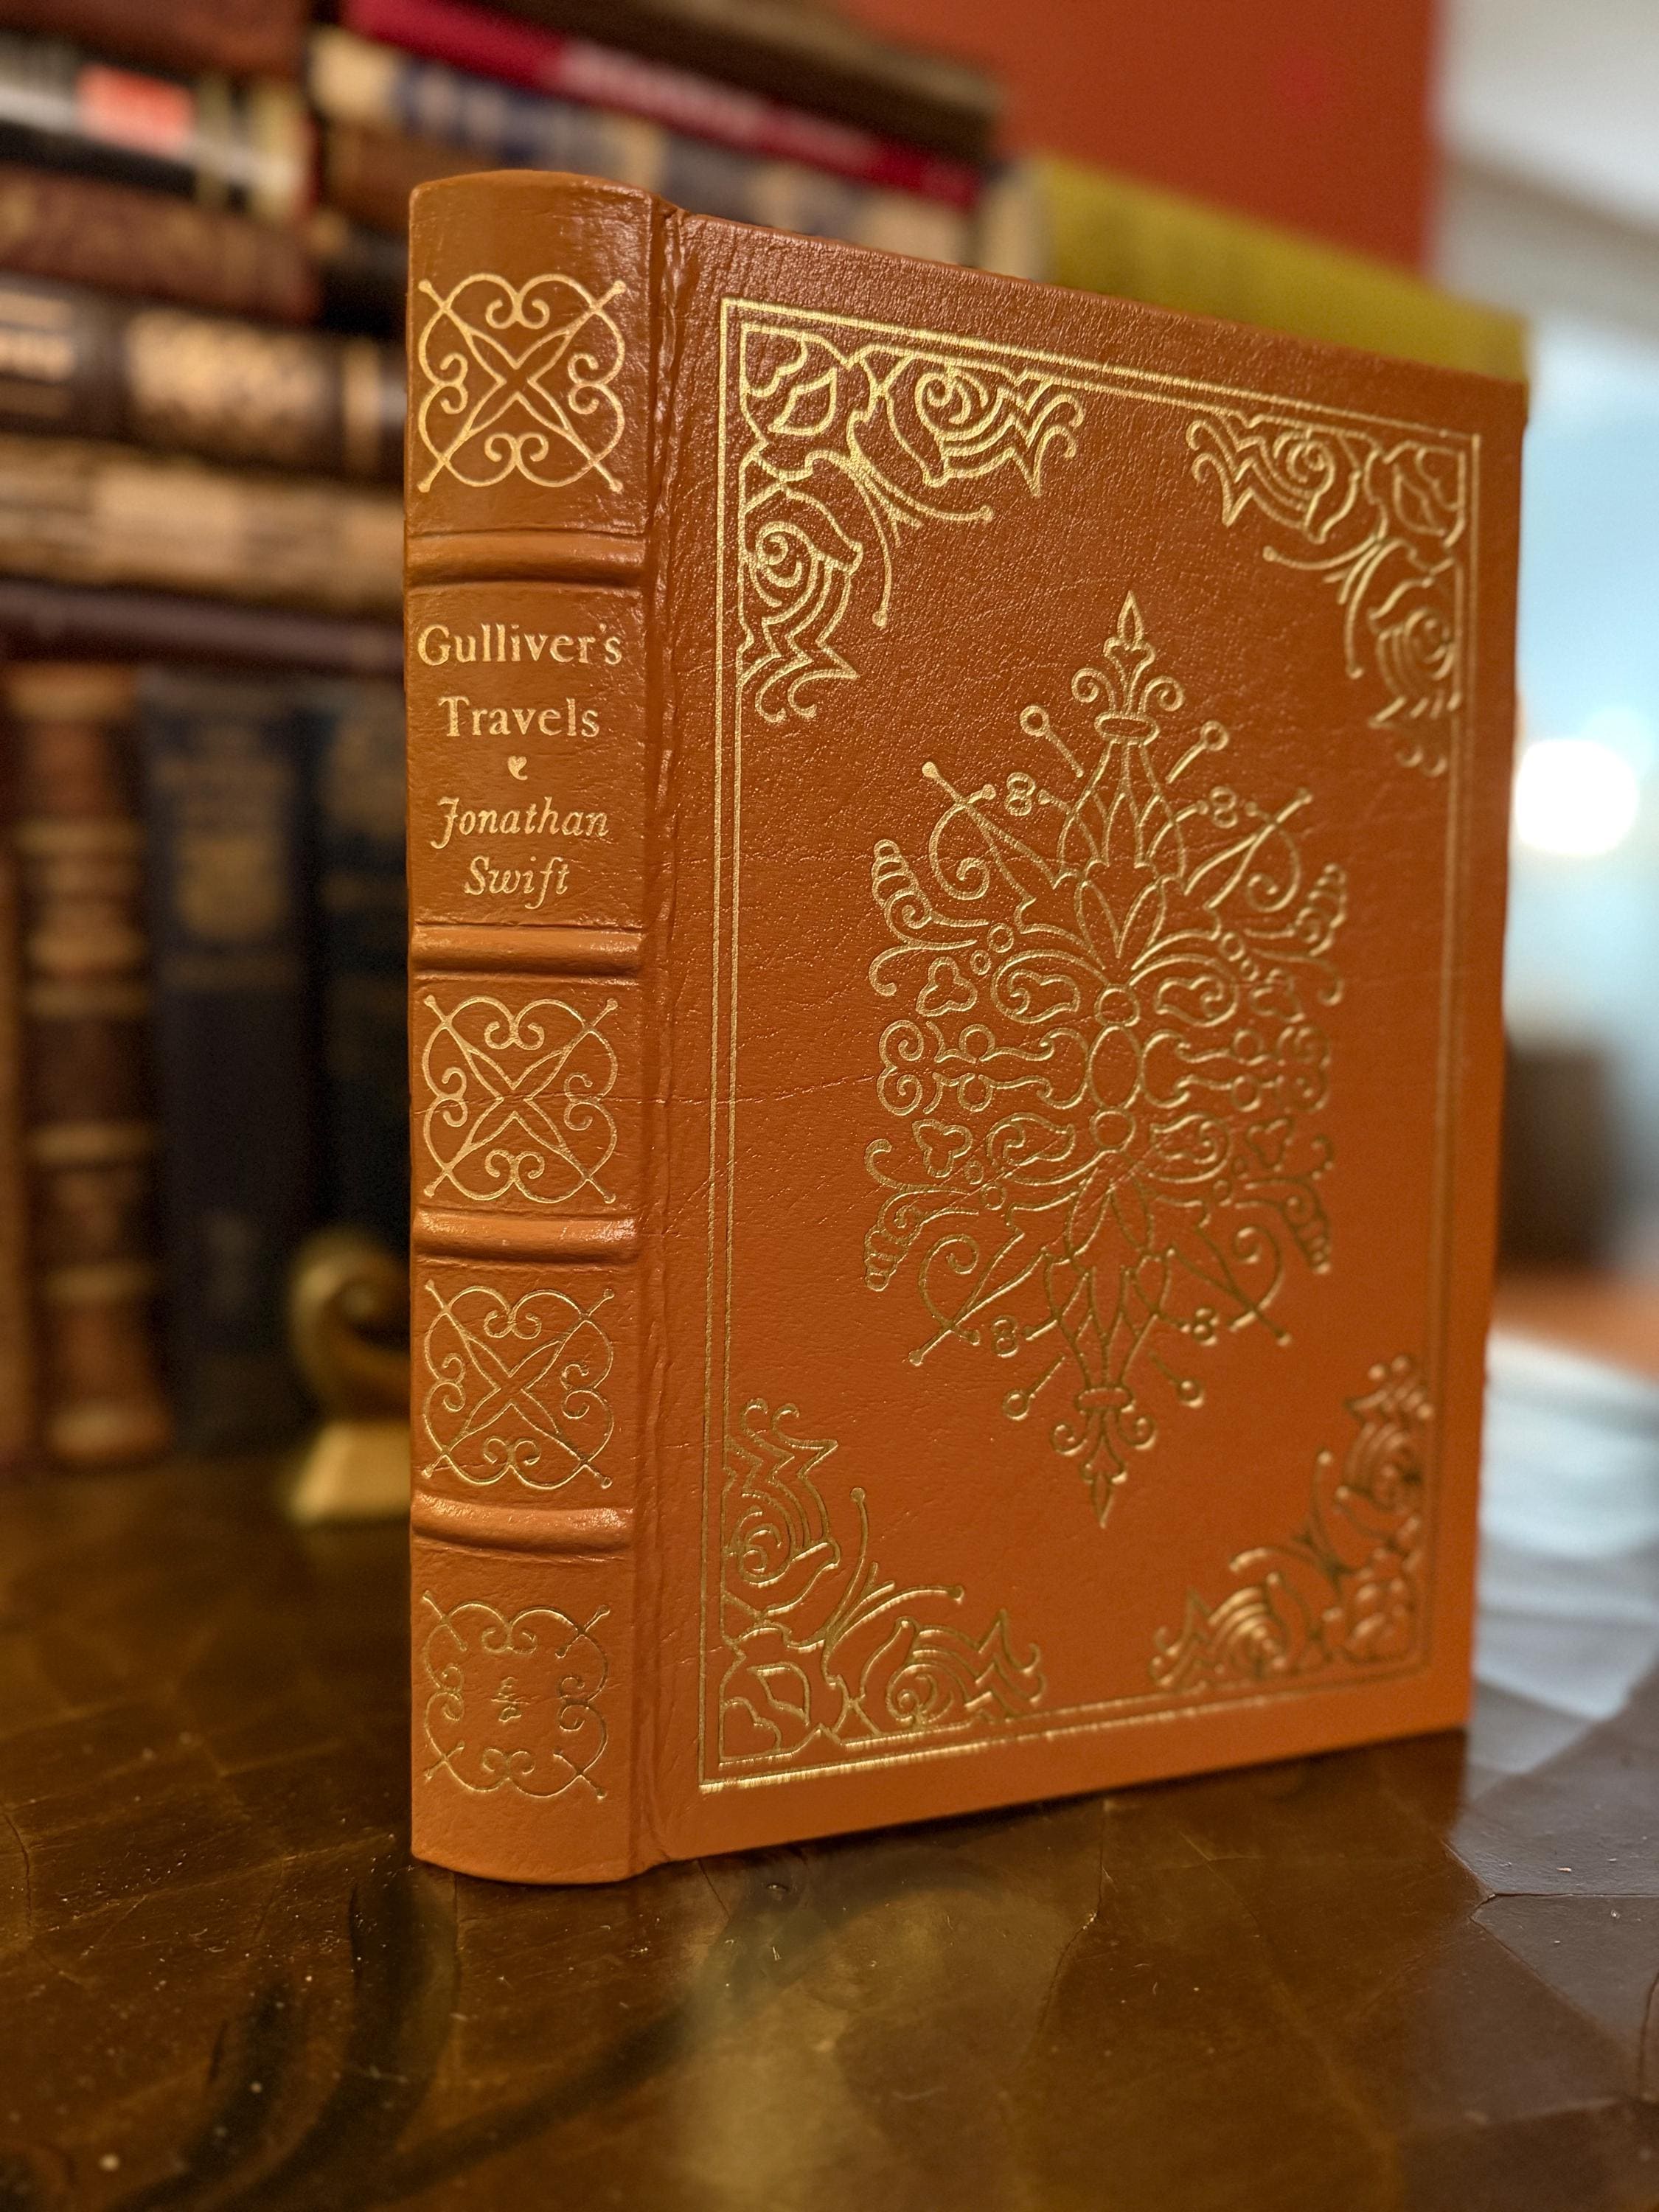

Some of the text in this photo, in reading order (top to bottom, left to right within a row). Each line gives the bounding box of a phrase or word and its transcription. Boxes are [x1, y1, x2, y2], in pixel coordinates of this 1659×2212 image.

[417, 622, 623, 667] Gulliver's
[437, 695, 600, 738] Travels
[430, 796, 610, 850] Jonathan
[464, 855, 571, 911] Swift
